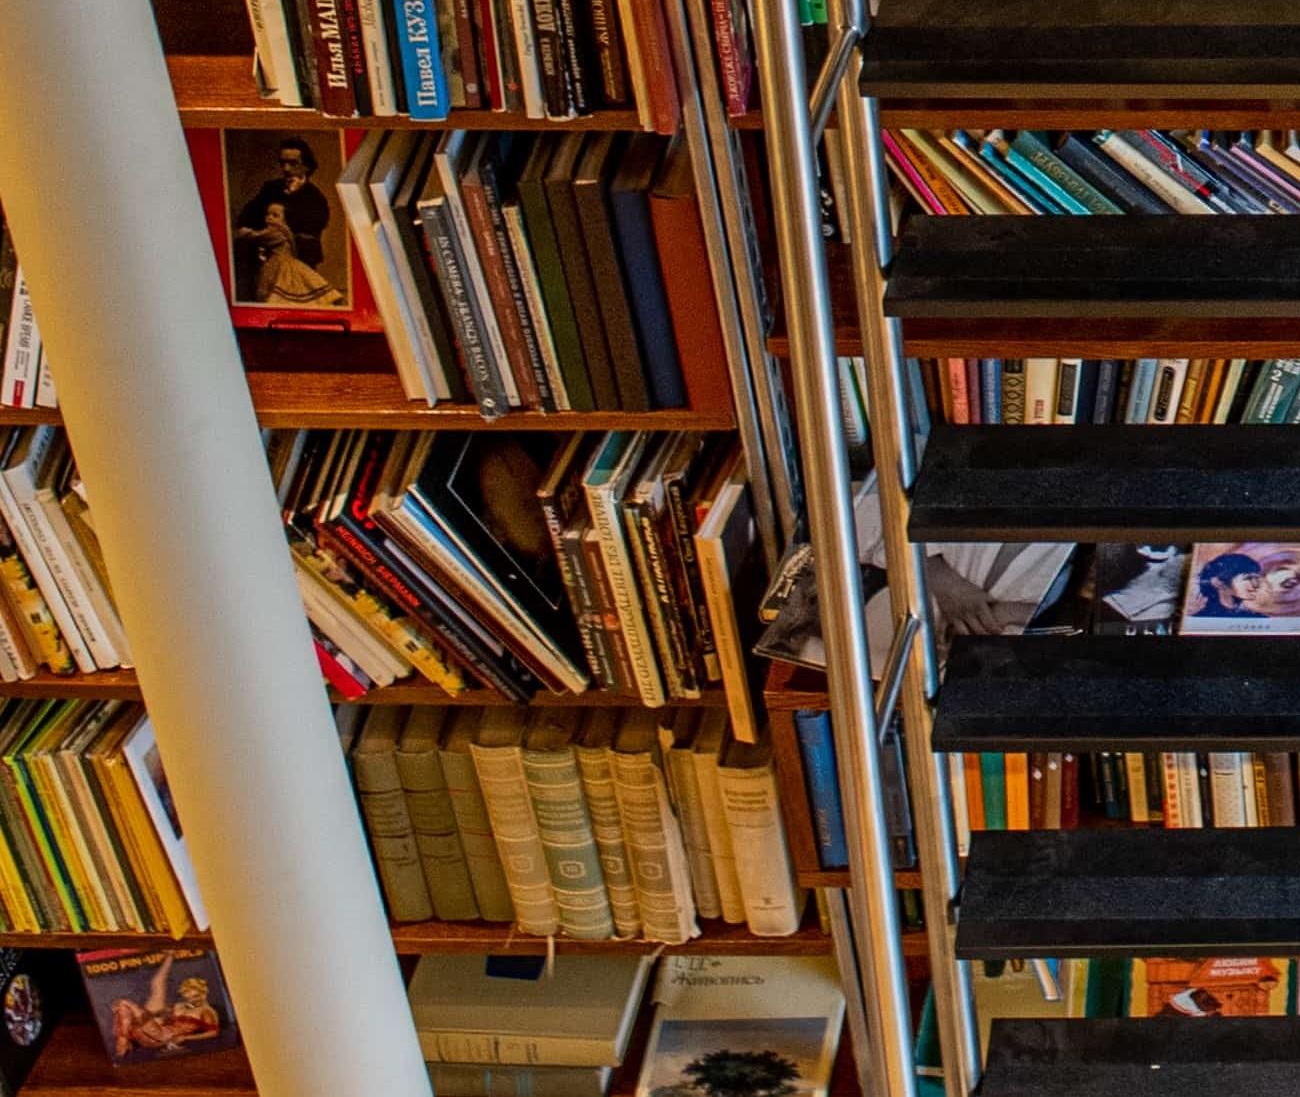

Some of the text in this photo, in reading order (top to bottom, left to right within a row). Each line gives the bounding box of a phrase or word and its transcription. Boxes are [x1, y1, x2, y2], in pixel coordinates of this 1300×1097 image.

[328, 41, 349, 90] Илья
[416, 47, 438, 108] Павел
[440, 247, 465, 296] CAMERA
[596, 492, 616, 543] LOUVRE
[606, 544, 622, 570] DES
[86, 961, 118, 975] 1000
[670, 968, 766, 989] Живопись
